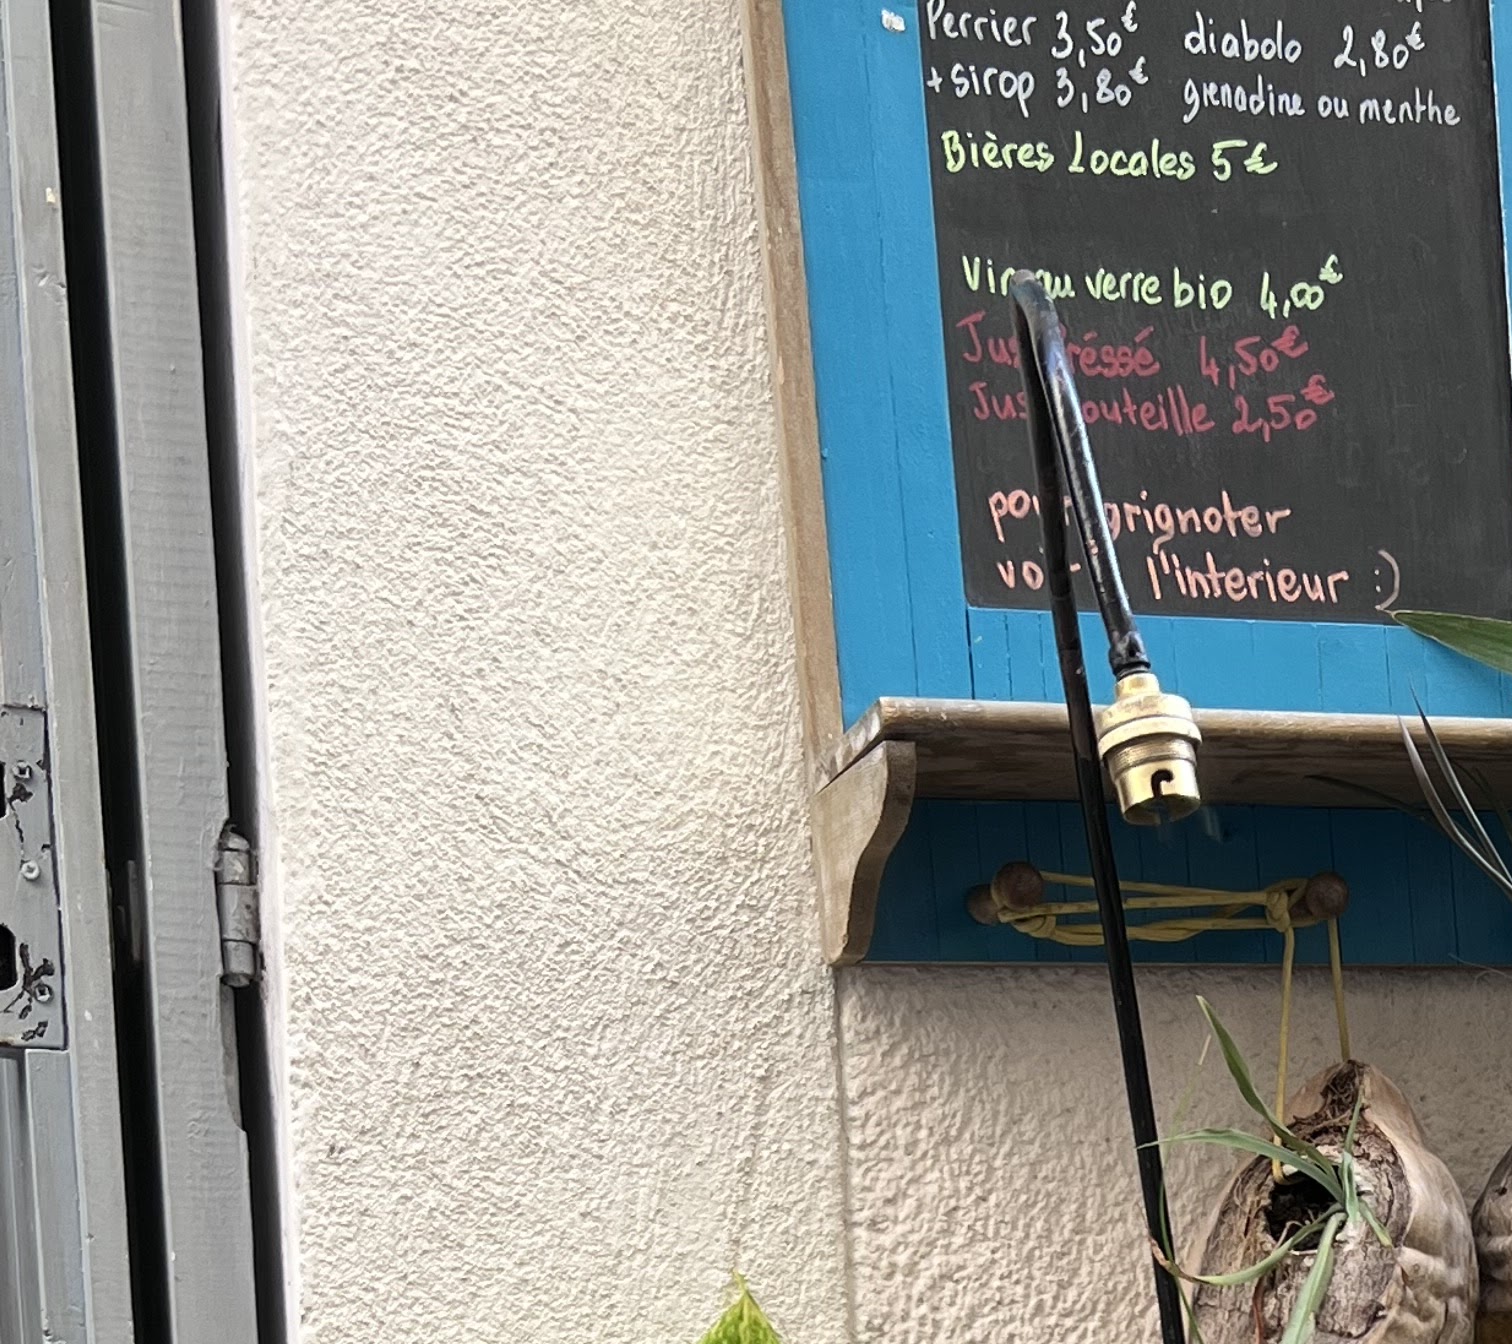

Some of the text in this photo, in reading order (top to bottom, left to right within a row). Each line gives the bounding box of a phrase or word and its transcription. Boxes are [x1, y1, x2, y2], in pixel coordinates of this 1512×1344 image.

[926, 0, 1037, 46] Perrier
[1184, 9, 1426, 77] diabolo 2,80€
[1056, 56, 1148, 113] 3,80€
[1183, 73, 1460, 126] grenadine ou menthe
[941, 129, 1054, 173] Bières
[1068, 130, 1196, 180] Locales
[1085, 267, 1162, 305] verre
[1173, 266, 1233, 310] bio
[1260, 254, 1344, 319] 4,00€
[1201, 325, 1309, 390] 4,50€
[1082, 384, 1215, 436] outeille
[1232, 374, 1335, 441] 2,50€
